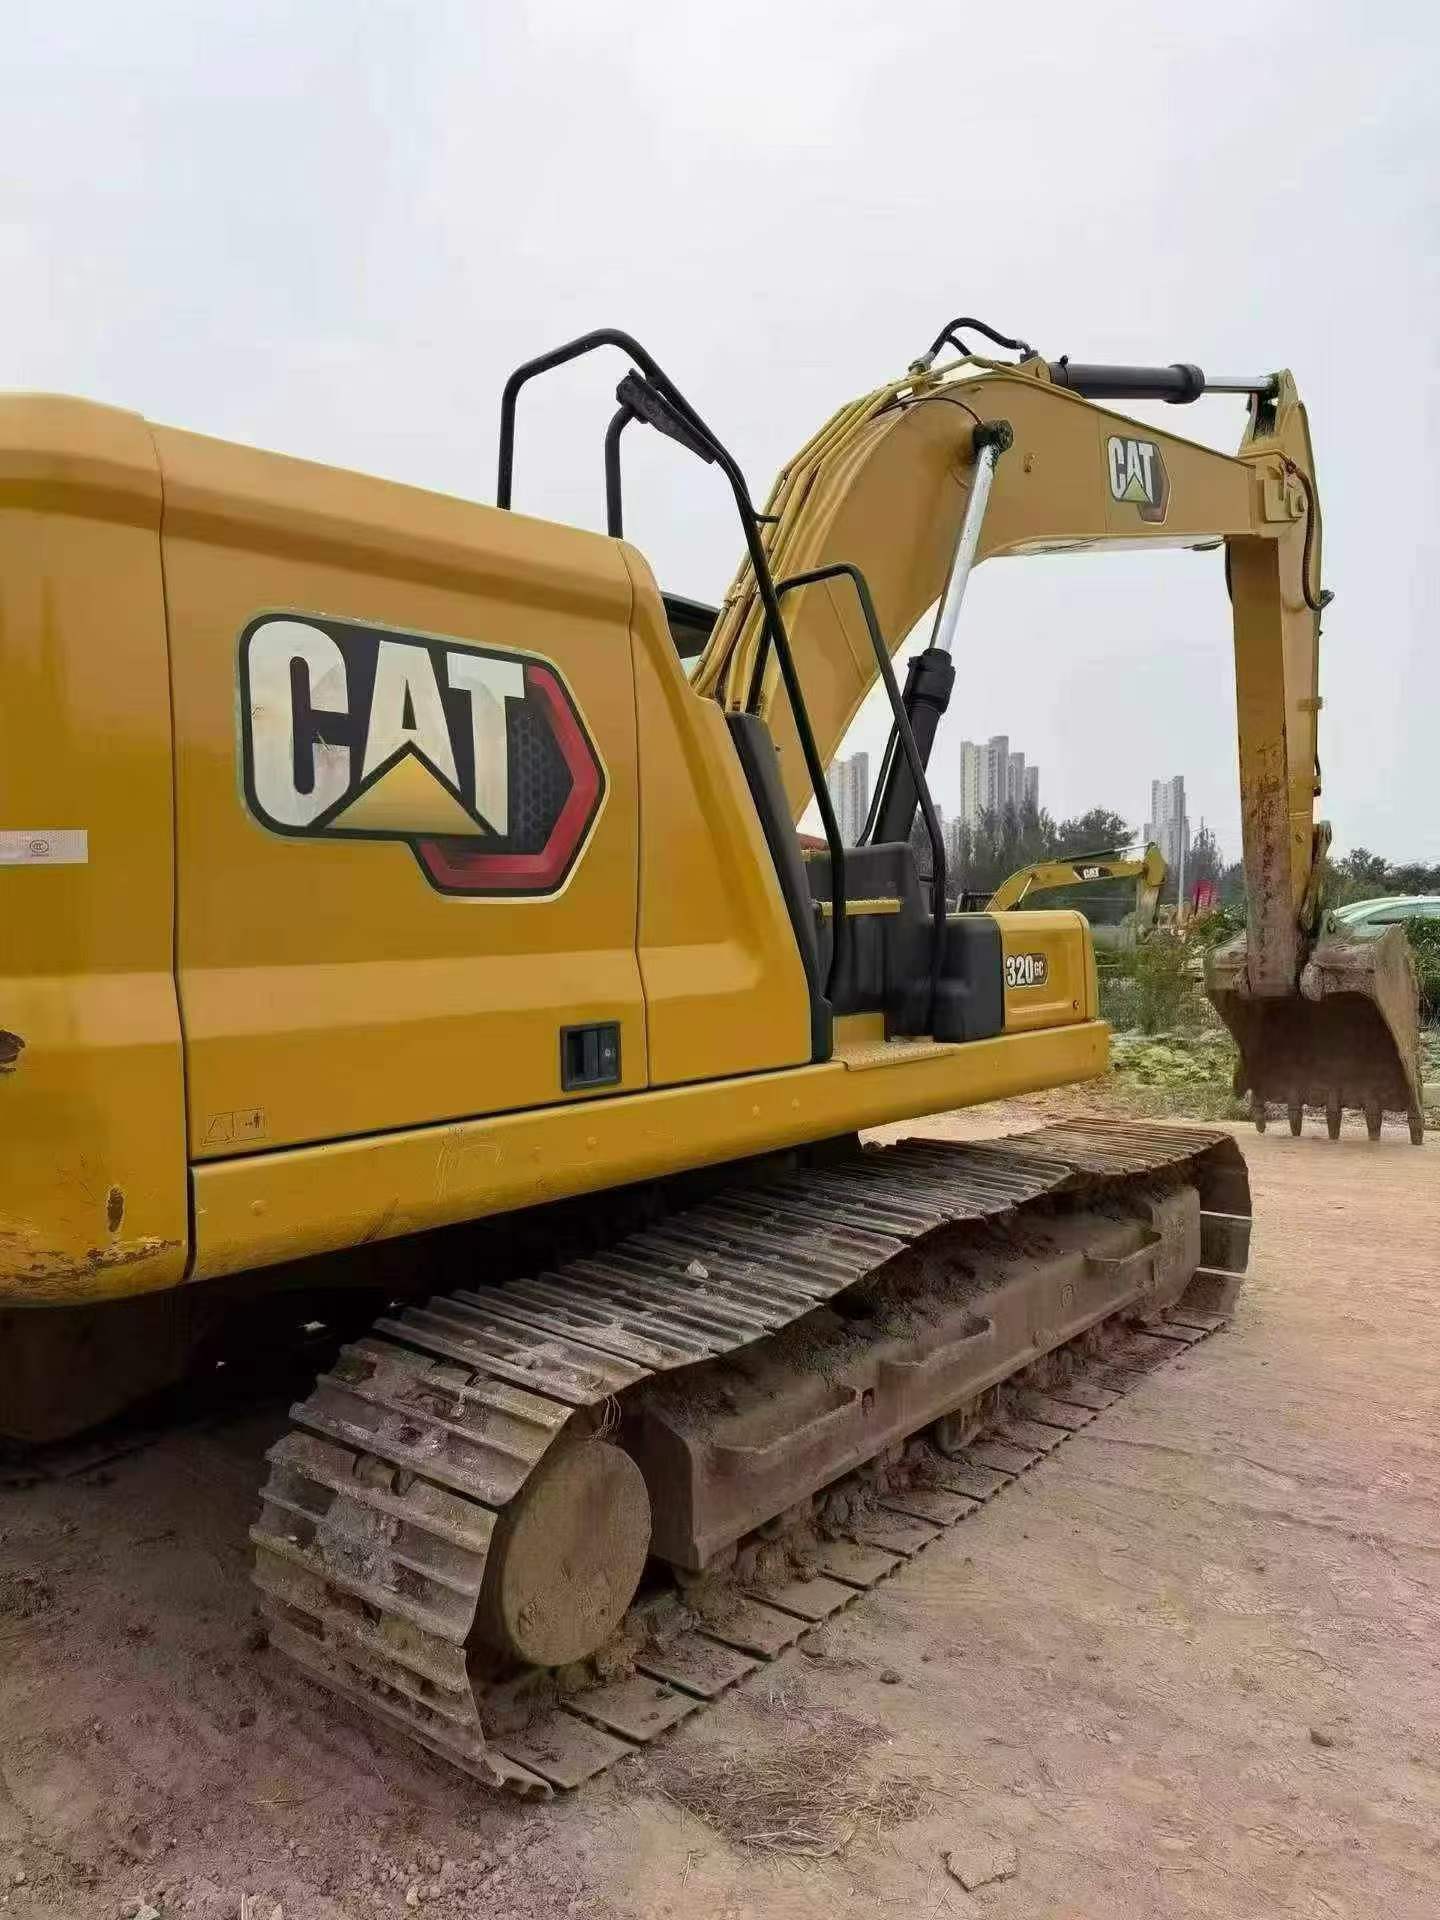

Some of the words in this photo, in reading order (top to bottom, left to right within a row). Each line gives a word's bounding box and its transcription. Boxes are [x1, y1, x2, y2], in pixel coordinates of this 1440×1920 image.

[1108, 436, 1154, 504] CAT
[247, 620, 526, 836] CAT
[1083, 867, 1100, 879] CAT
[1006, 954, 1034, 987] 320
